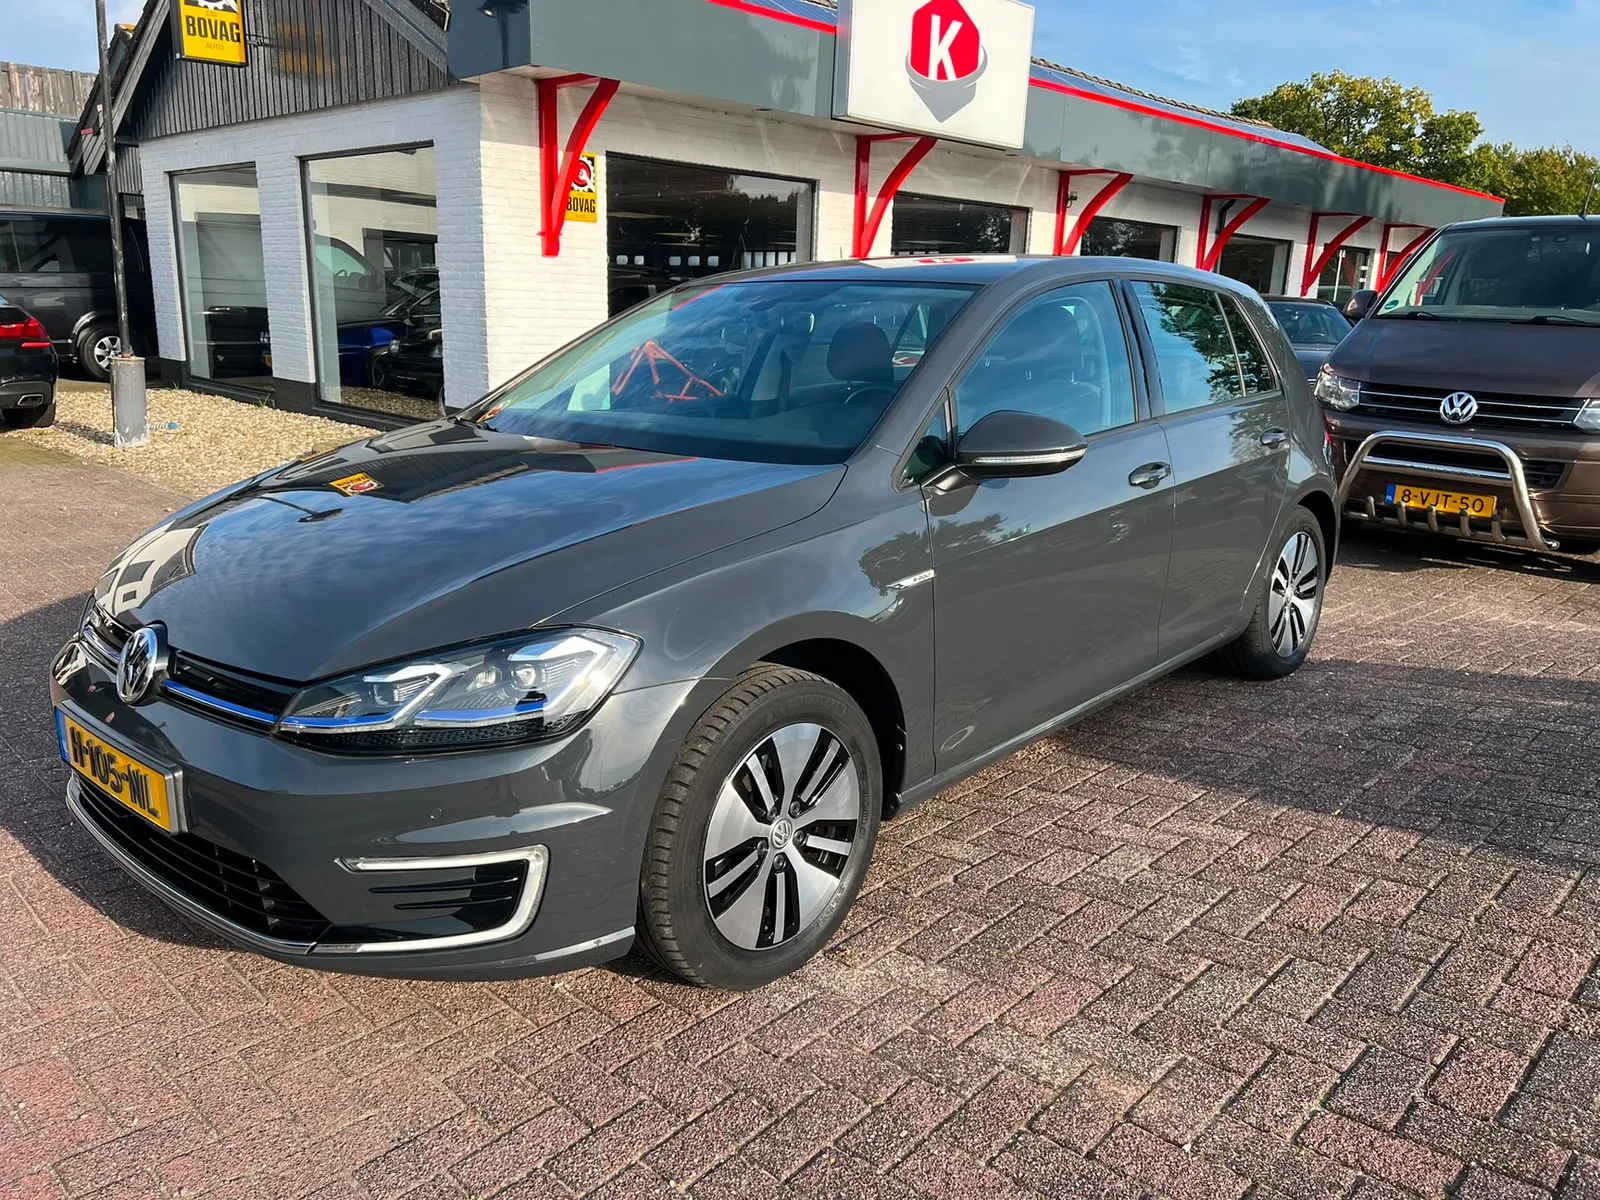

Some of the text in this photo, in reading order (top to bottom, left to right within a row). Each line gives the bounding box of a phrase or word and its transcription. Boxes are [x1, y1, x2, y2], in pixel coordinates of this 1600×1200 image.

[185, 15, 241, 43] BOVAG
[205, 42, 224, 51] AUTO
[928, 14, 963, 81] K
[566, 196, 596, 213] BOVAG
[1401, 488, 1485, 513] 8-VJT-50
[69, 726, 161, 819] H-105-NL
